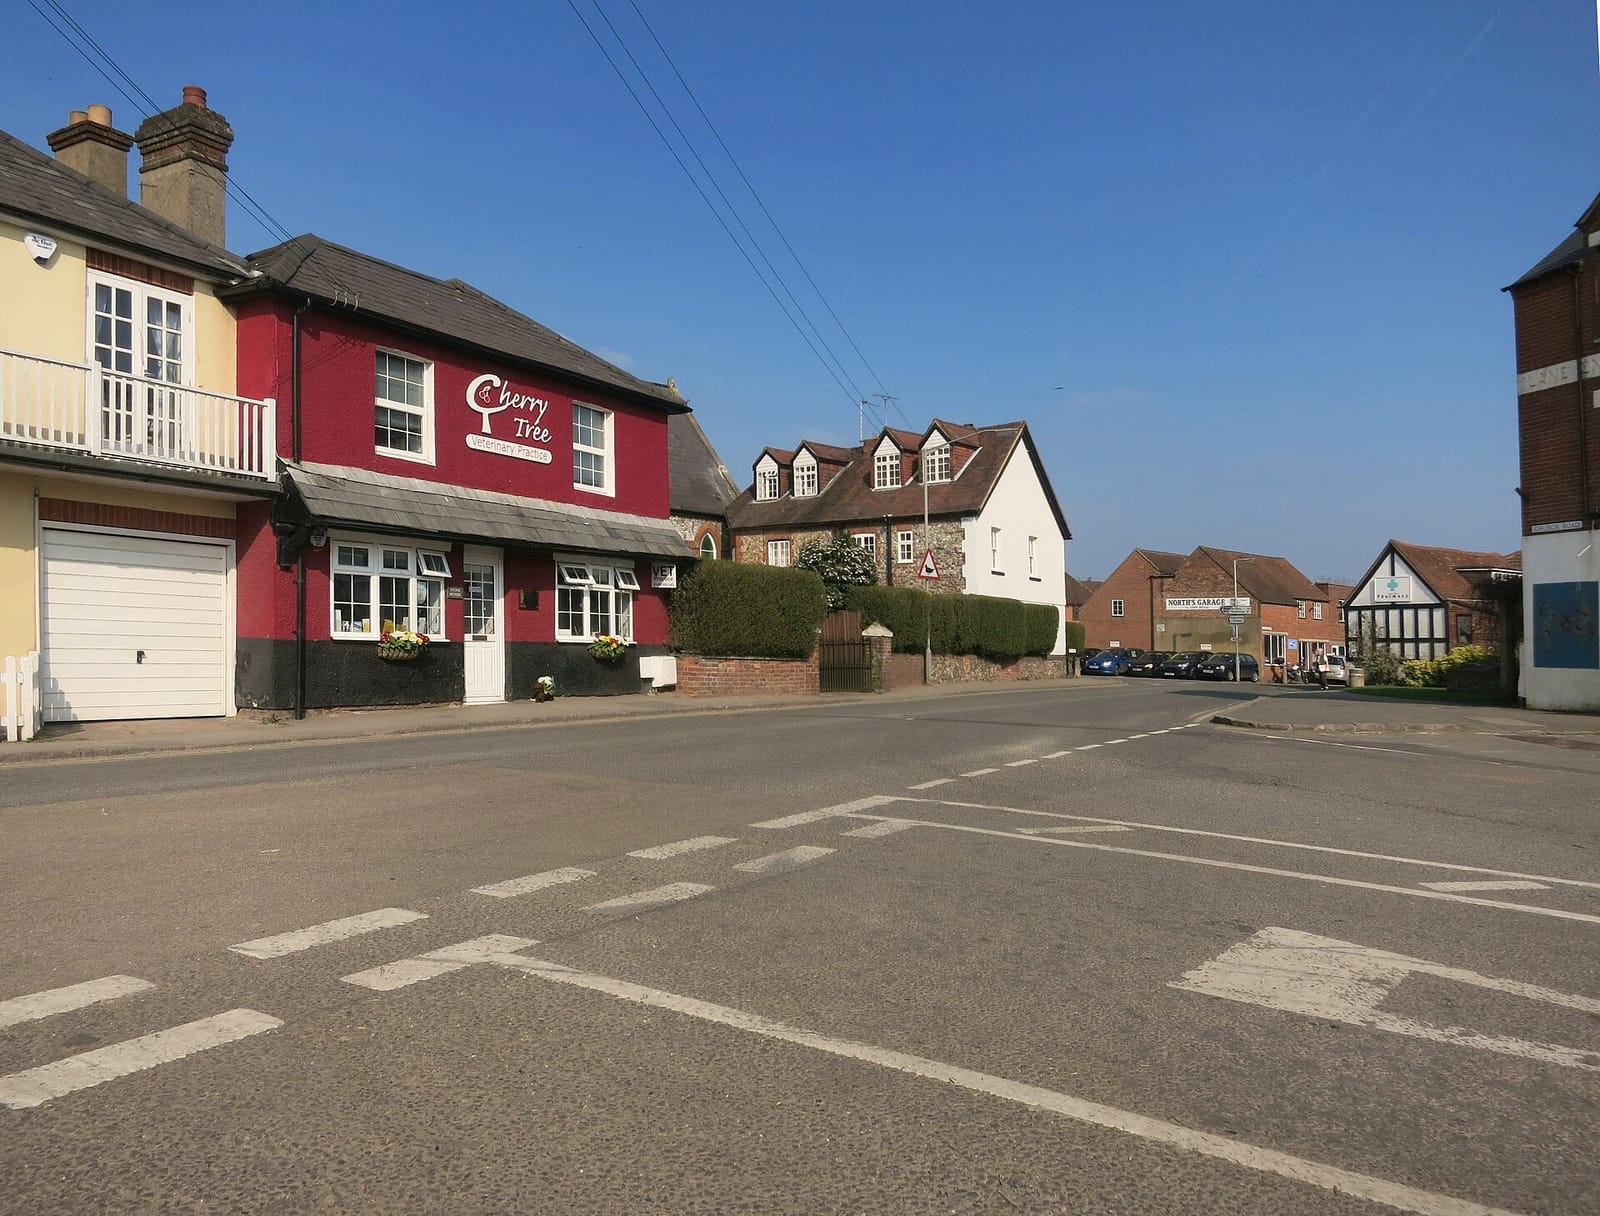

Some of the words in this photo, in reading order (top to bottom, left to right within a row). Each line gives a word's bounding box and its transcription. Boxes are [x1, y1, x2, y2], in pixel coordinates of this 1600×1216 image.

[466, 373, 548, 431] Cherry
[514, 418, 552, 443] Tree
[471, 436, 515, 455] Veterinary
[518, 446, 548, 461] Practice
[652, 565, 674, 577] VET
[1168, 599, 1196, 607] NORTH'S
[1197, 598, 1226, 607] GARAGE
